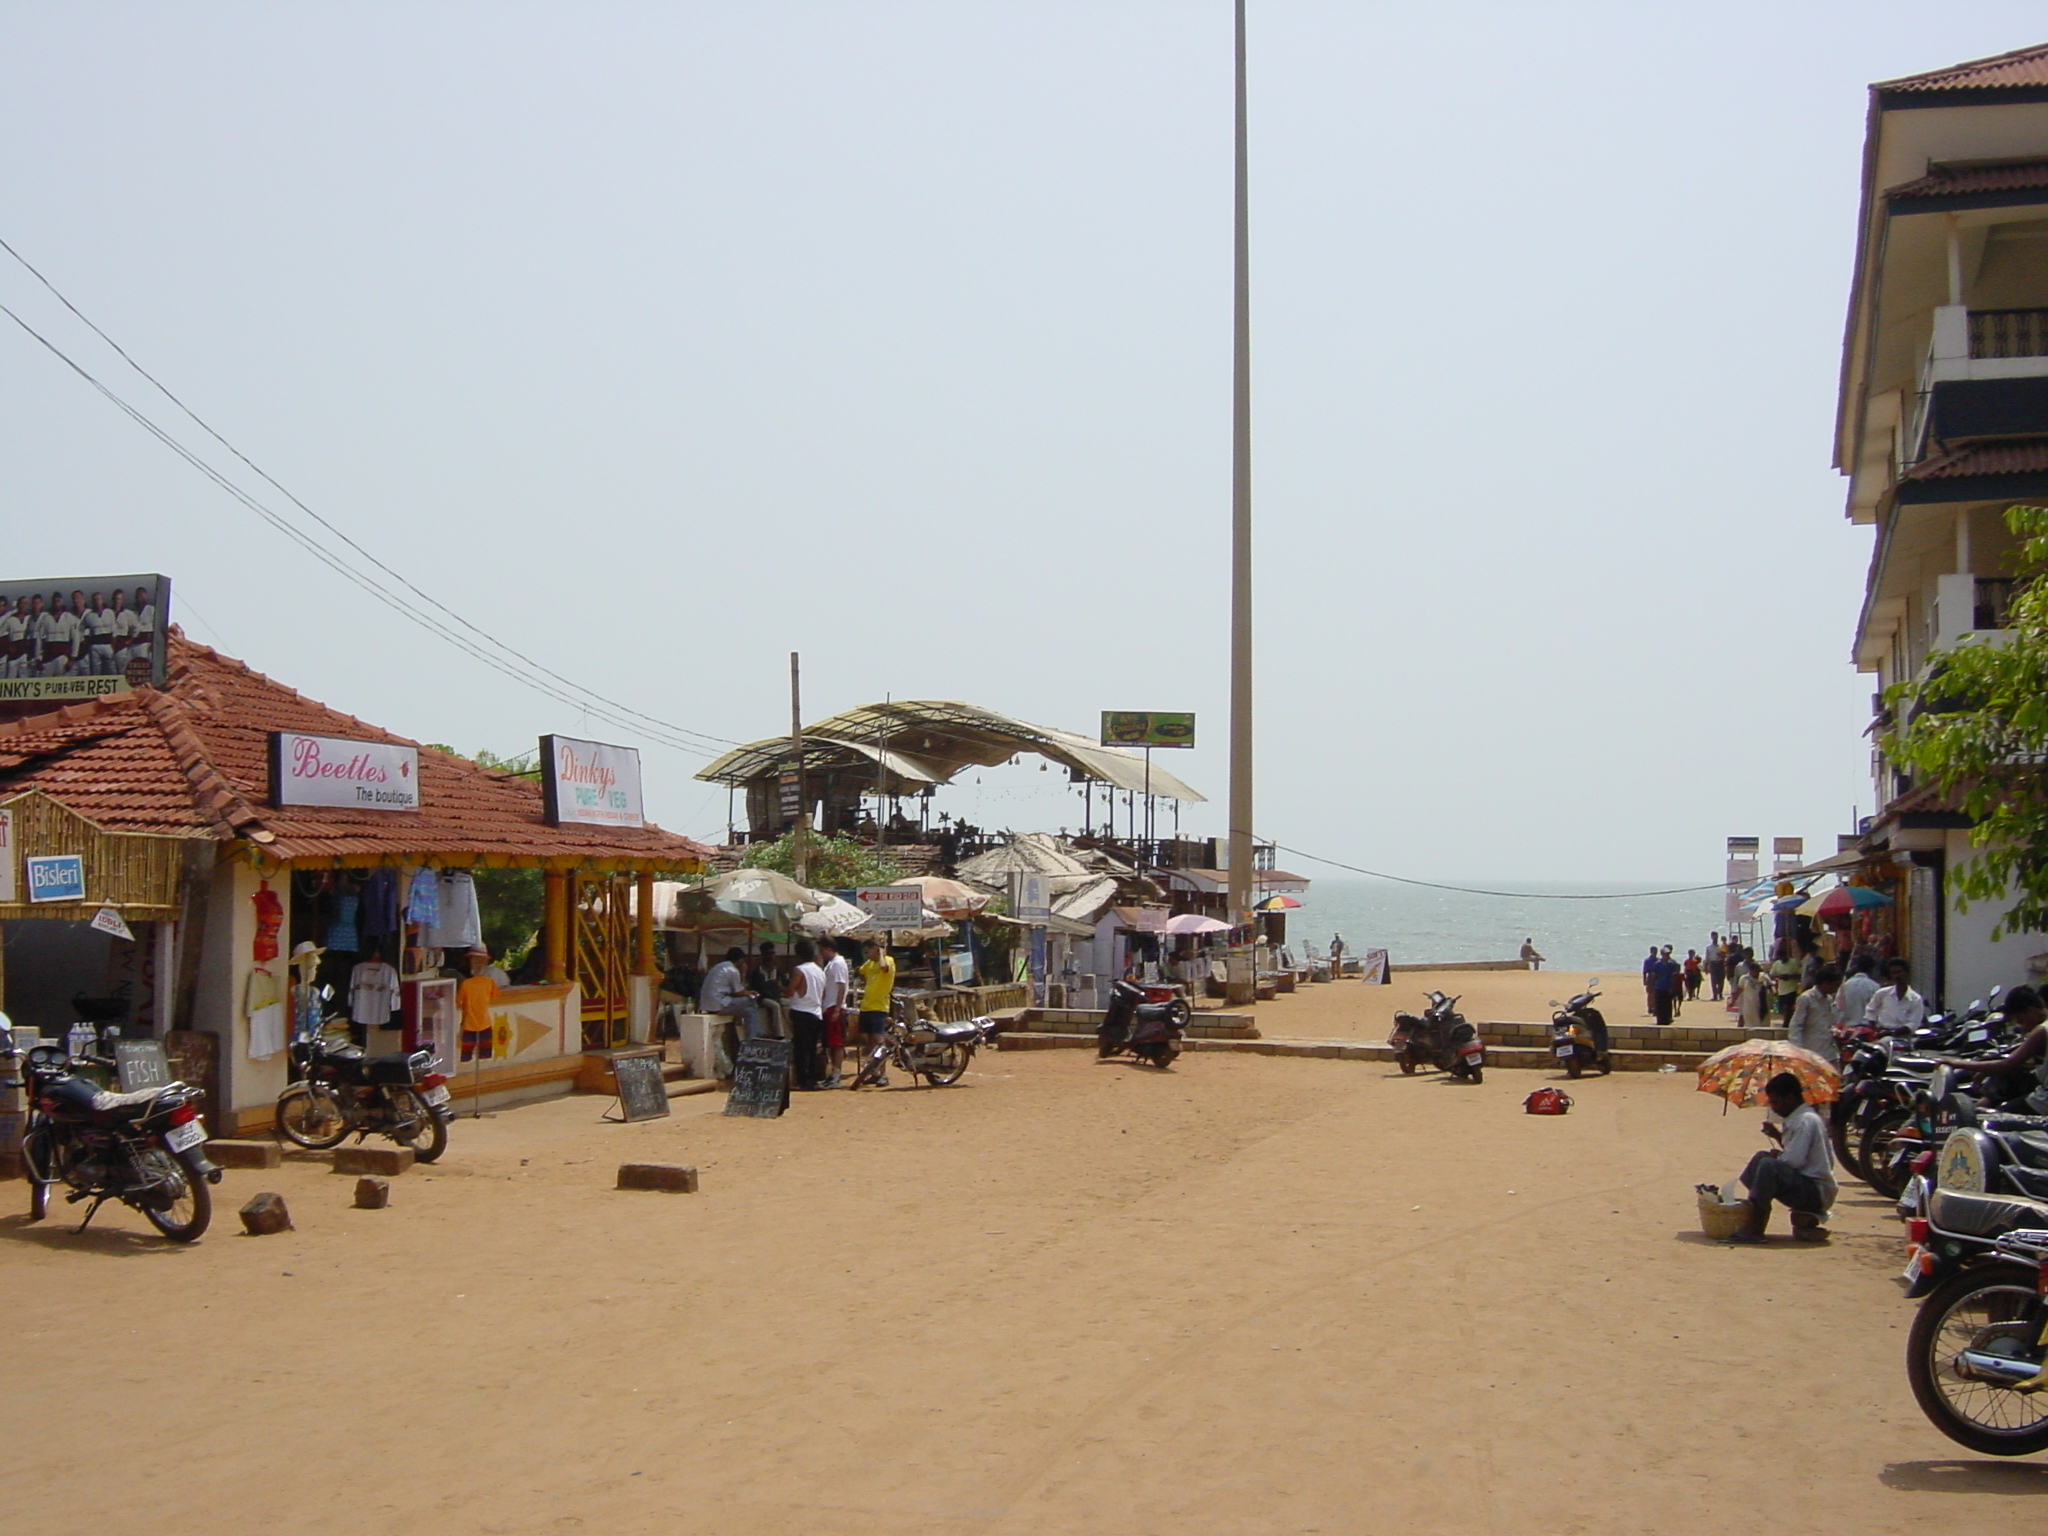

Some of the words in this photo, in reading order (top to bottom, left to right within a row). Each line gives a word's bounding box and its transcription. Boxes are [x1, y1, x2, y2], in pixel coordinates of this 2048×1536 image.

[87, 679, 118, 695] REST
[292, 736, 388, 783] Beetles
[356, 786, 373, 802] The
[375, 788, 413, 806] boutique
[33, 864, 79, 888] Bisleri
[126, 1060, 159, 1085] FISH
